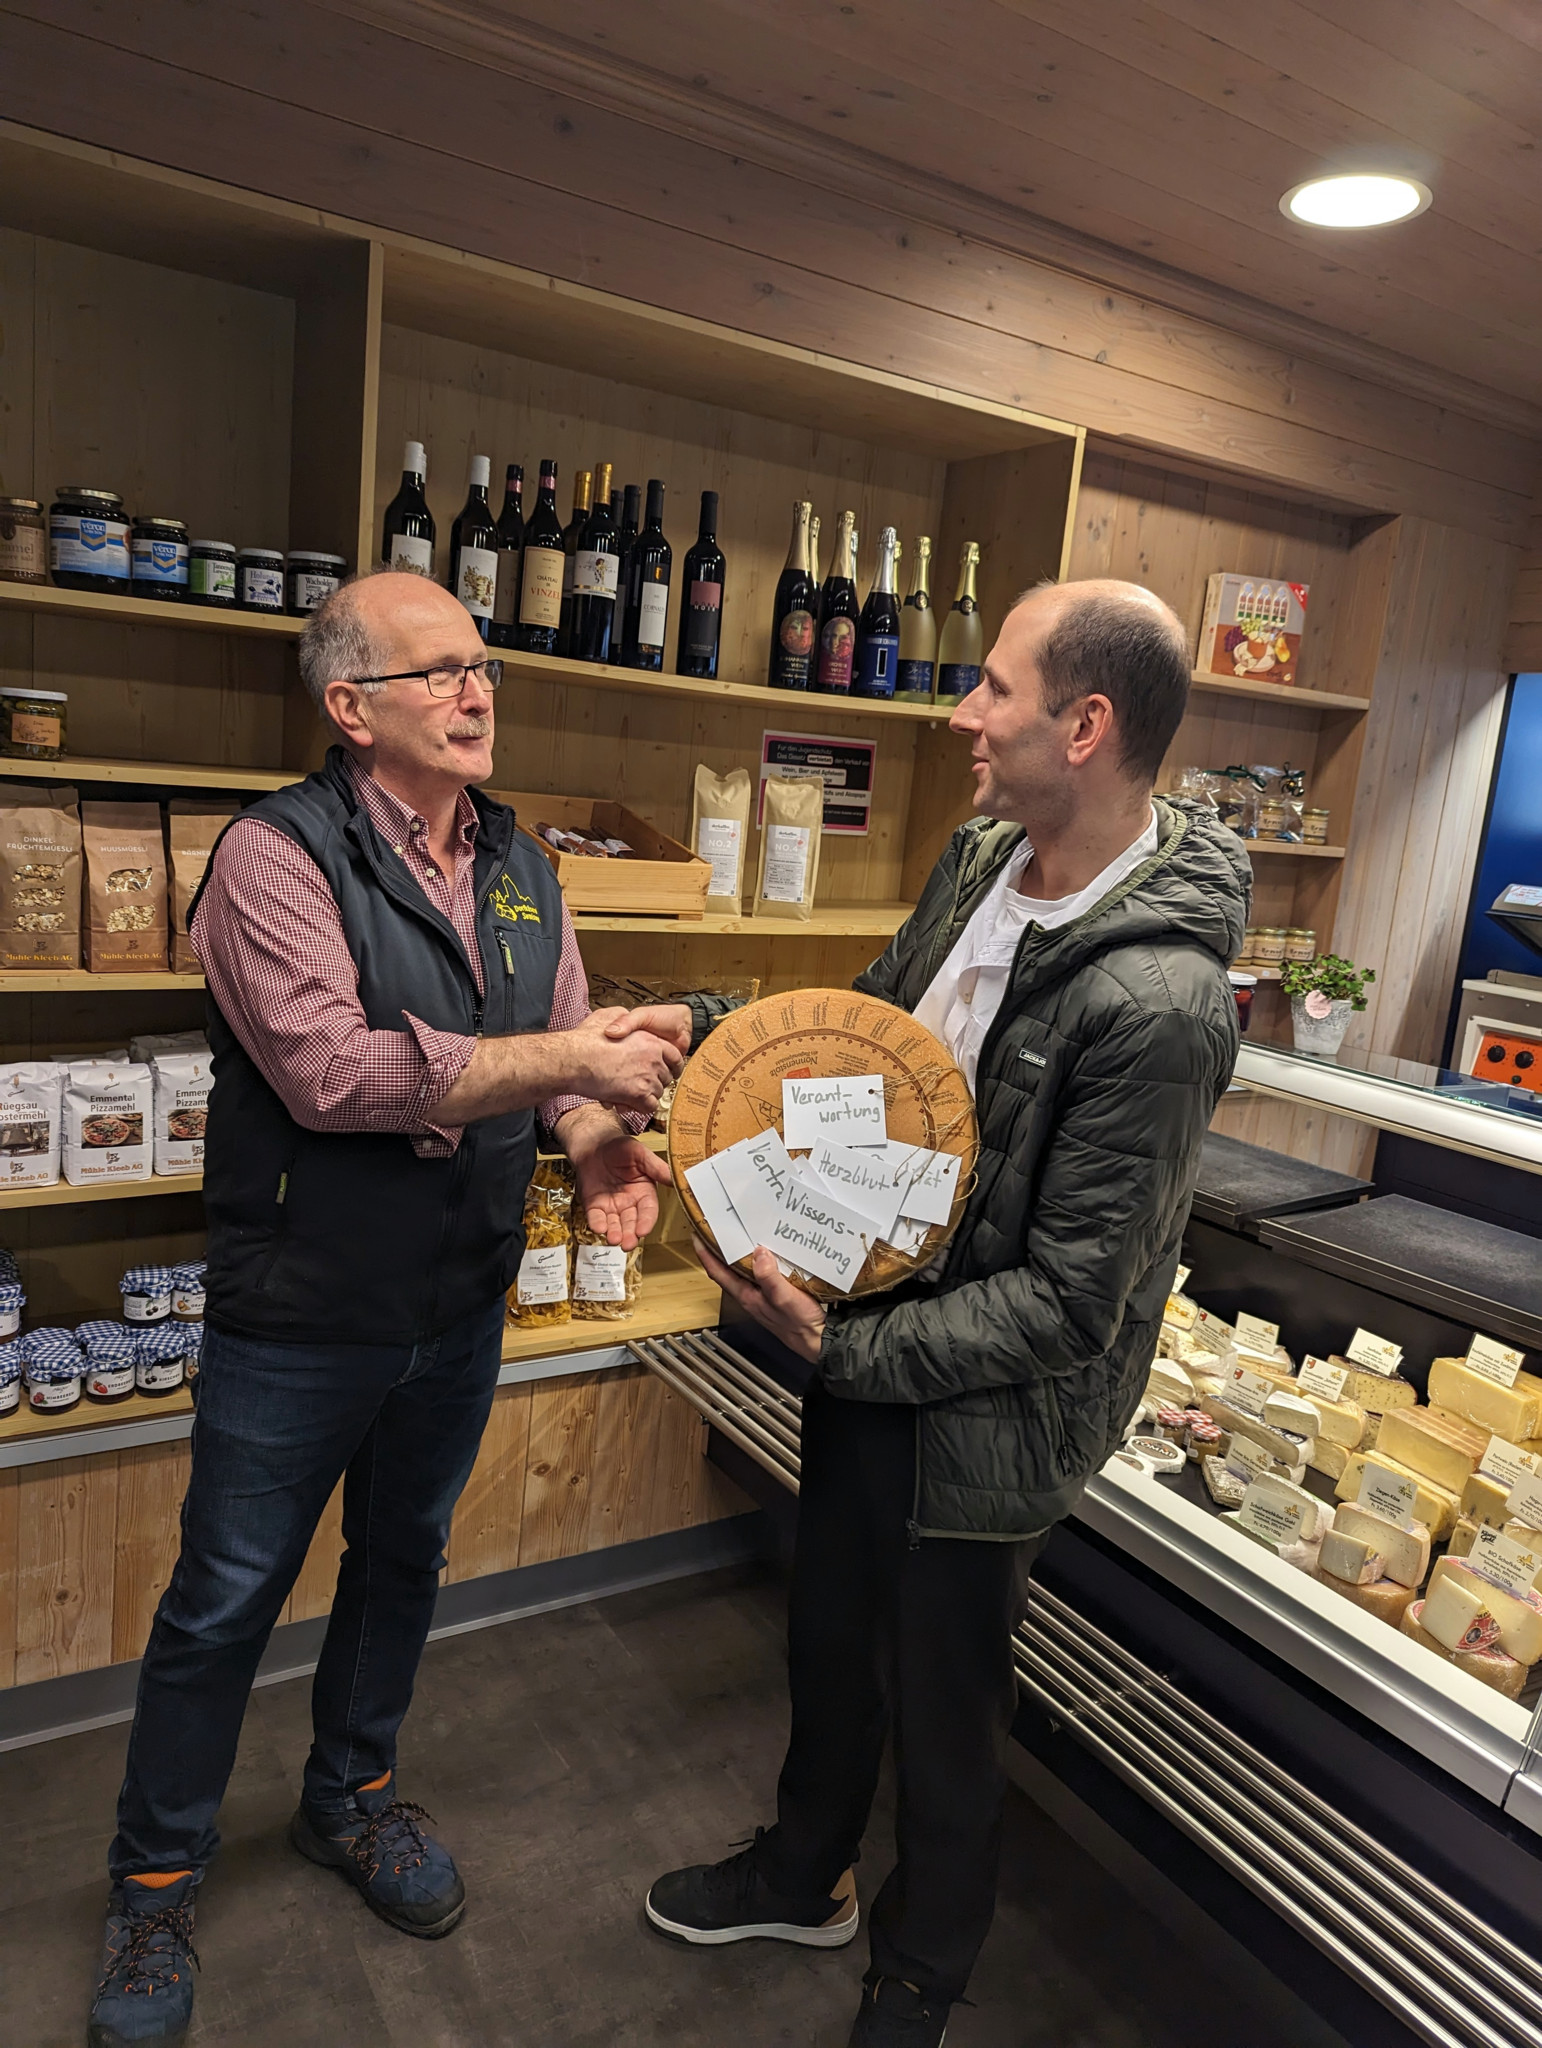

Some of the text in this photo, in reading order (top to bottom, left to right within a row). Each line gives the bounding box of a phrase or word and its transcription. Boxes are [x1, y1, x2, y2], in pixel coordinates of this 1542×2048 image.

[530, 587, 561, 600] VINZEL
[23, 836, 56, 844] DINKEL-
[708, 839, 732, 849] NO.2
[6, 842, 73, 853] FRÜCHTEMÜESLI
[775, 843, 799, 852] NO.4
[90, 1093, 136, 1103] Emmental
[791, 1083, 854, 1105] Verant-
[90, 1103, 136, 1113] Pizzamehl
[176, 1099, 208, 1108] Pizzam
[819, 1102, 881, 1123] wortung
[81, 1166, 105, 1175] Mühle
[107, 1164, 130, 1173] Kleeb
[131, 1163, 144, 1171] AG
[818, 1149, 890, 1191] Herzblut
[36, 1172, 48, 1180] AG
[784, 1184, 855, 1238] Wissens-
[1134, 1438, 1178, 1459] TOMME
[1488, 1549, 1497, 1558] BIO
